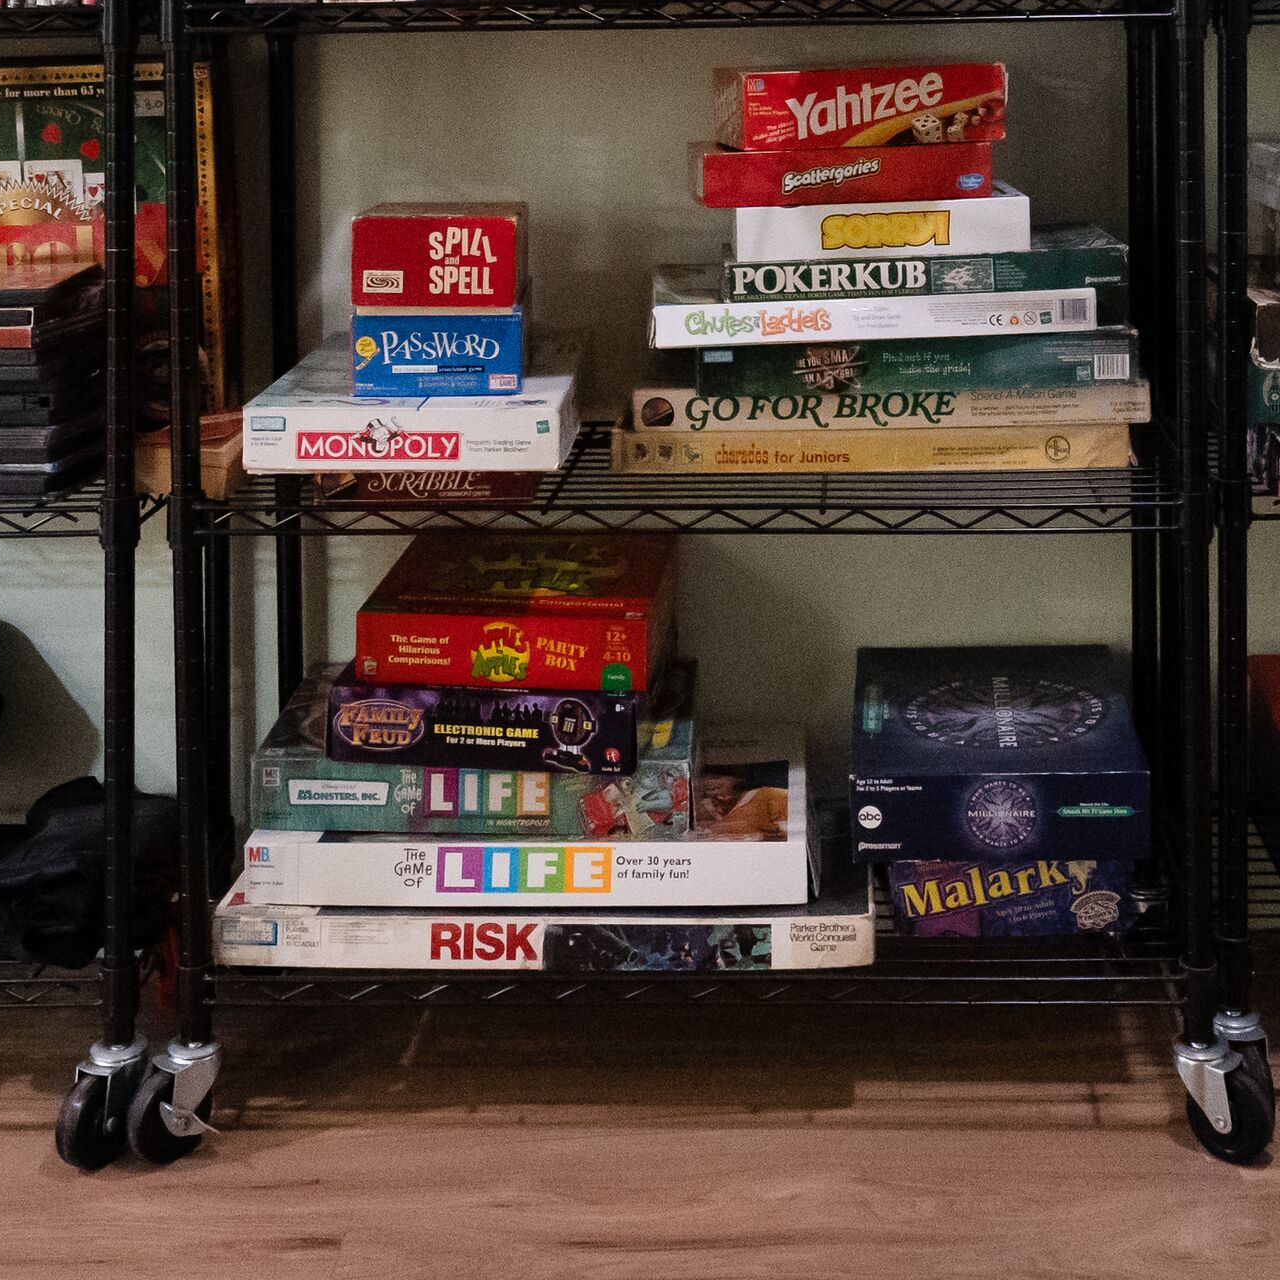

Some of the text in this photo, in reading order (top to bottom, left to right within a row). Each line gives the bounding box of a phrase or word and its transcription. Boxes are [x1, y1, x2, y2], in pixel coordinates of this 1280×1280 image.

[785, 72, 945, 142] Yahtzee
[783, 158, 881, 193] Scattergories
[428, 226, 498, 264] SPILL
[428, 265, 494, 296] SPELL
[733, 260, 927, 295] POKERKUB
[380, 330, 500, 365] PASSWORD
[685, 395, 740, 431] GO
[833, 391, 957, 426] BROKE
[299, 433, 458, 458] MONOPOLY
[798, 449, 850, 465] Juniors
[390, 634, 438, 644] The Game
[536, 636, 589, 658] PARTY
[544, 654, 578, 673] BOX
[340, 702, 424, 732] FAMILY
[992, 676, 1018, 749] MILLIONAIRE
[352, 724, 412, 746] FEUD
[433, 724, 540, 739] ELECTRONIC GAME
[858, 811, 882, 822] abc
[967, 809, 1037, 818] MILLIONAIRE
[248, 846, 270, 863] MB
[616, 855, 693, 869] Over 30 years
[443, 851, 607, 889] LIFE
[617, 867, 690, 882] of family fun!
[900, 859, 1098, 919] Malarky
[789, 921, 819, 933] Parker
[430, 922, 540, 961] RISK
